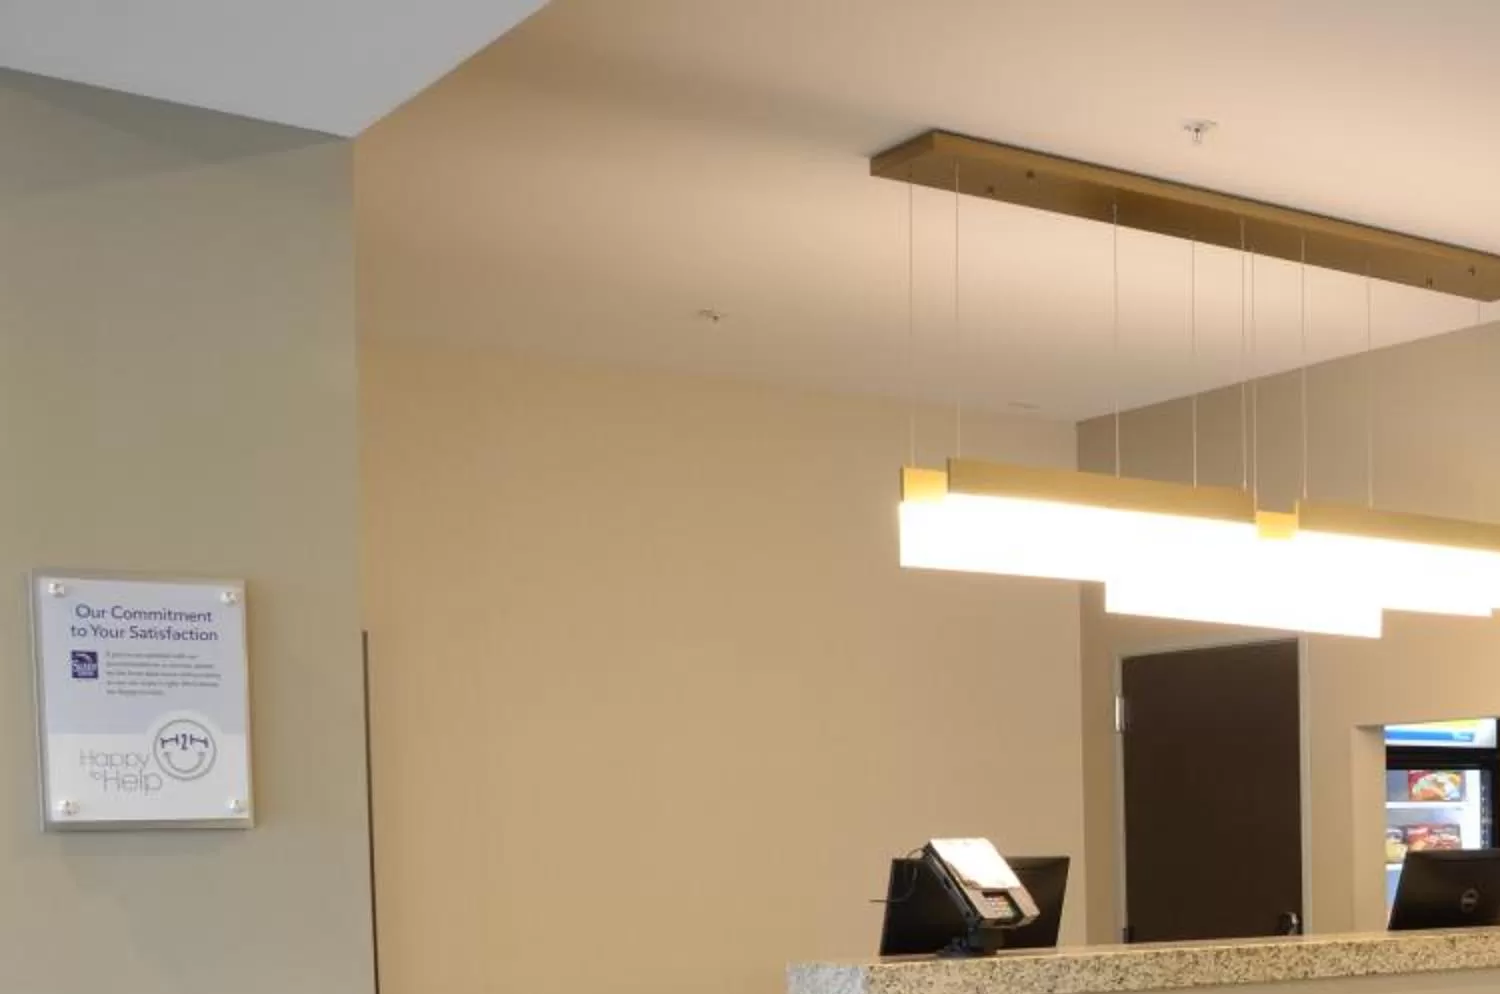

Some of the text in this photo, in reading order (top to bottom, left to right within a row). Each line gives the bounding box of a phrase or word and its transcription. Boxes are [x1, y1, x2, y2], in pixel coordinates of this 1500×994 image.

[75, 603, 212, 622] Our Commitment
[70, 625, 218, 641] to Your Satisfaction
[79, 749, 151, 768] Happy
[103, 768, 163, 796] Help
